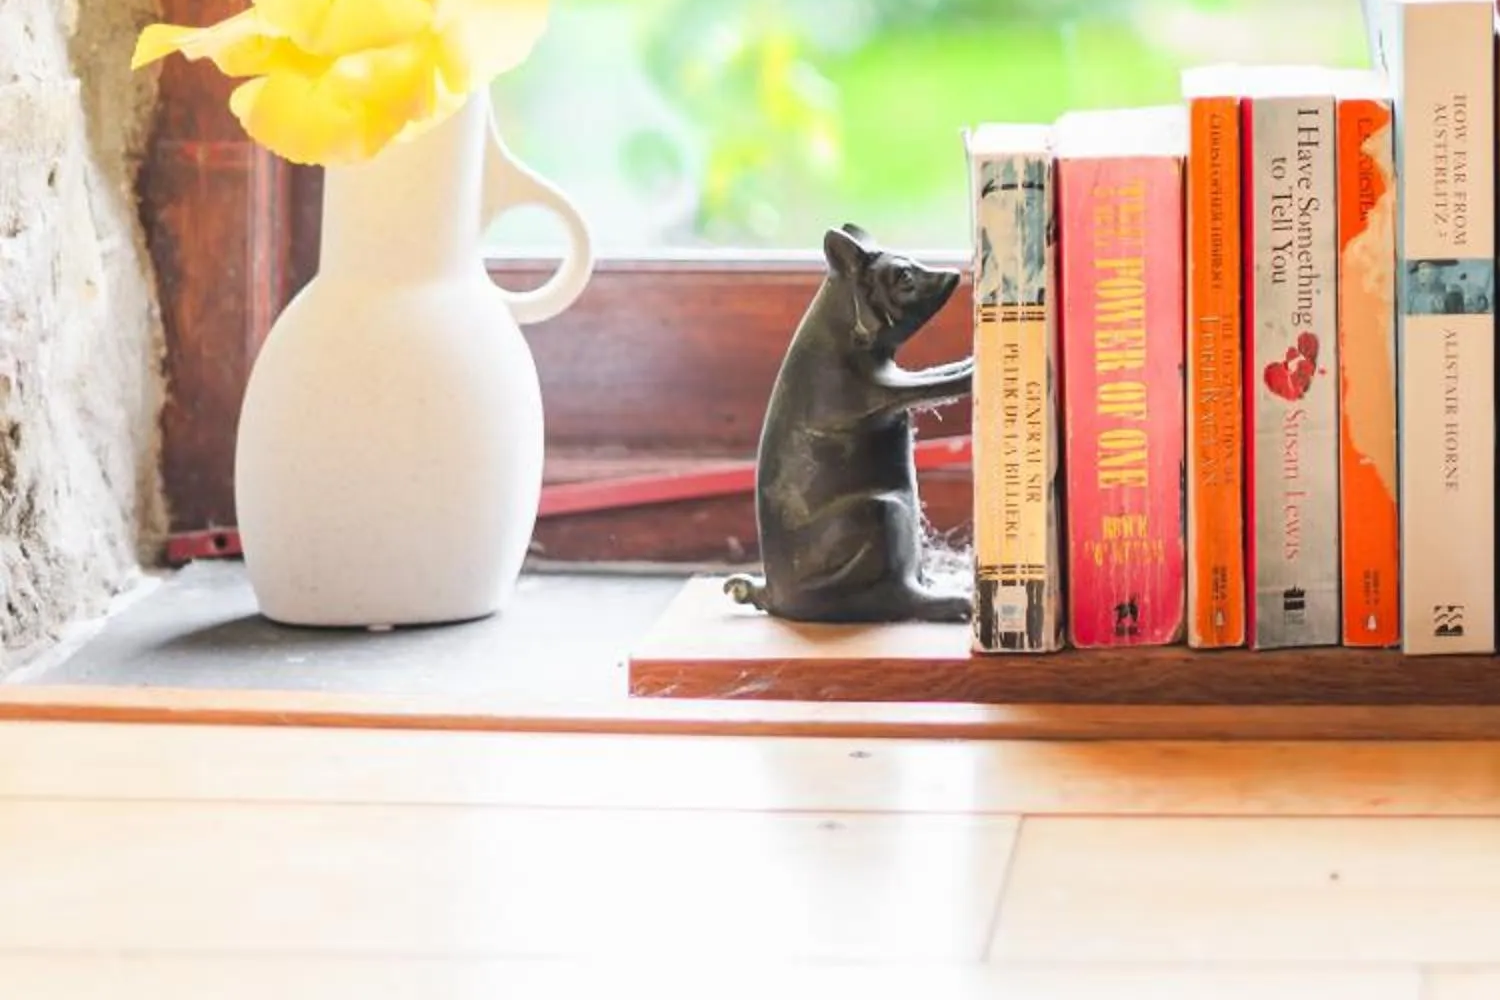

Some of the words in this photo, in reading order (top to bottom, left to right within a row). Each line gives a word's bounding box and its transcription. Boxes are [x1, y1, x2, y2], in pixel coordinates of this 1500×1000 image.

[1297, 108, 1319, 116] I
[1453, 94, 1469, 141] HOW
[1271, 157, 1290, 181] to
[1297, 126, 1319, 190] Have
[1453, 150, 1467, 184] FAR
[1271, 186, 1293, 232] Tell
[1453, 191, 1468, 247] FROM
[1271, 239, 1293, 286] You
[1292, 196, 1321, 327] Something
[1095, 257, 1147, 373] POWER
[1003, 343, 1020, 399] PETER
[1444, 328, 1460, 416] ALISTAIR
[1026, 381, 1042, 464] GENERAL
[1095, 380, 1148, 419] OF
[1097, 428, 1149, 489] ONE
[1283, 408, 1306, 480] Susan
[1444, 422, 1459, 493] HORNE
[1026, 473, 1042, 504] SIR
[1282, 489, 1308, 560] Lewis
